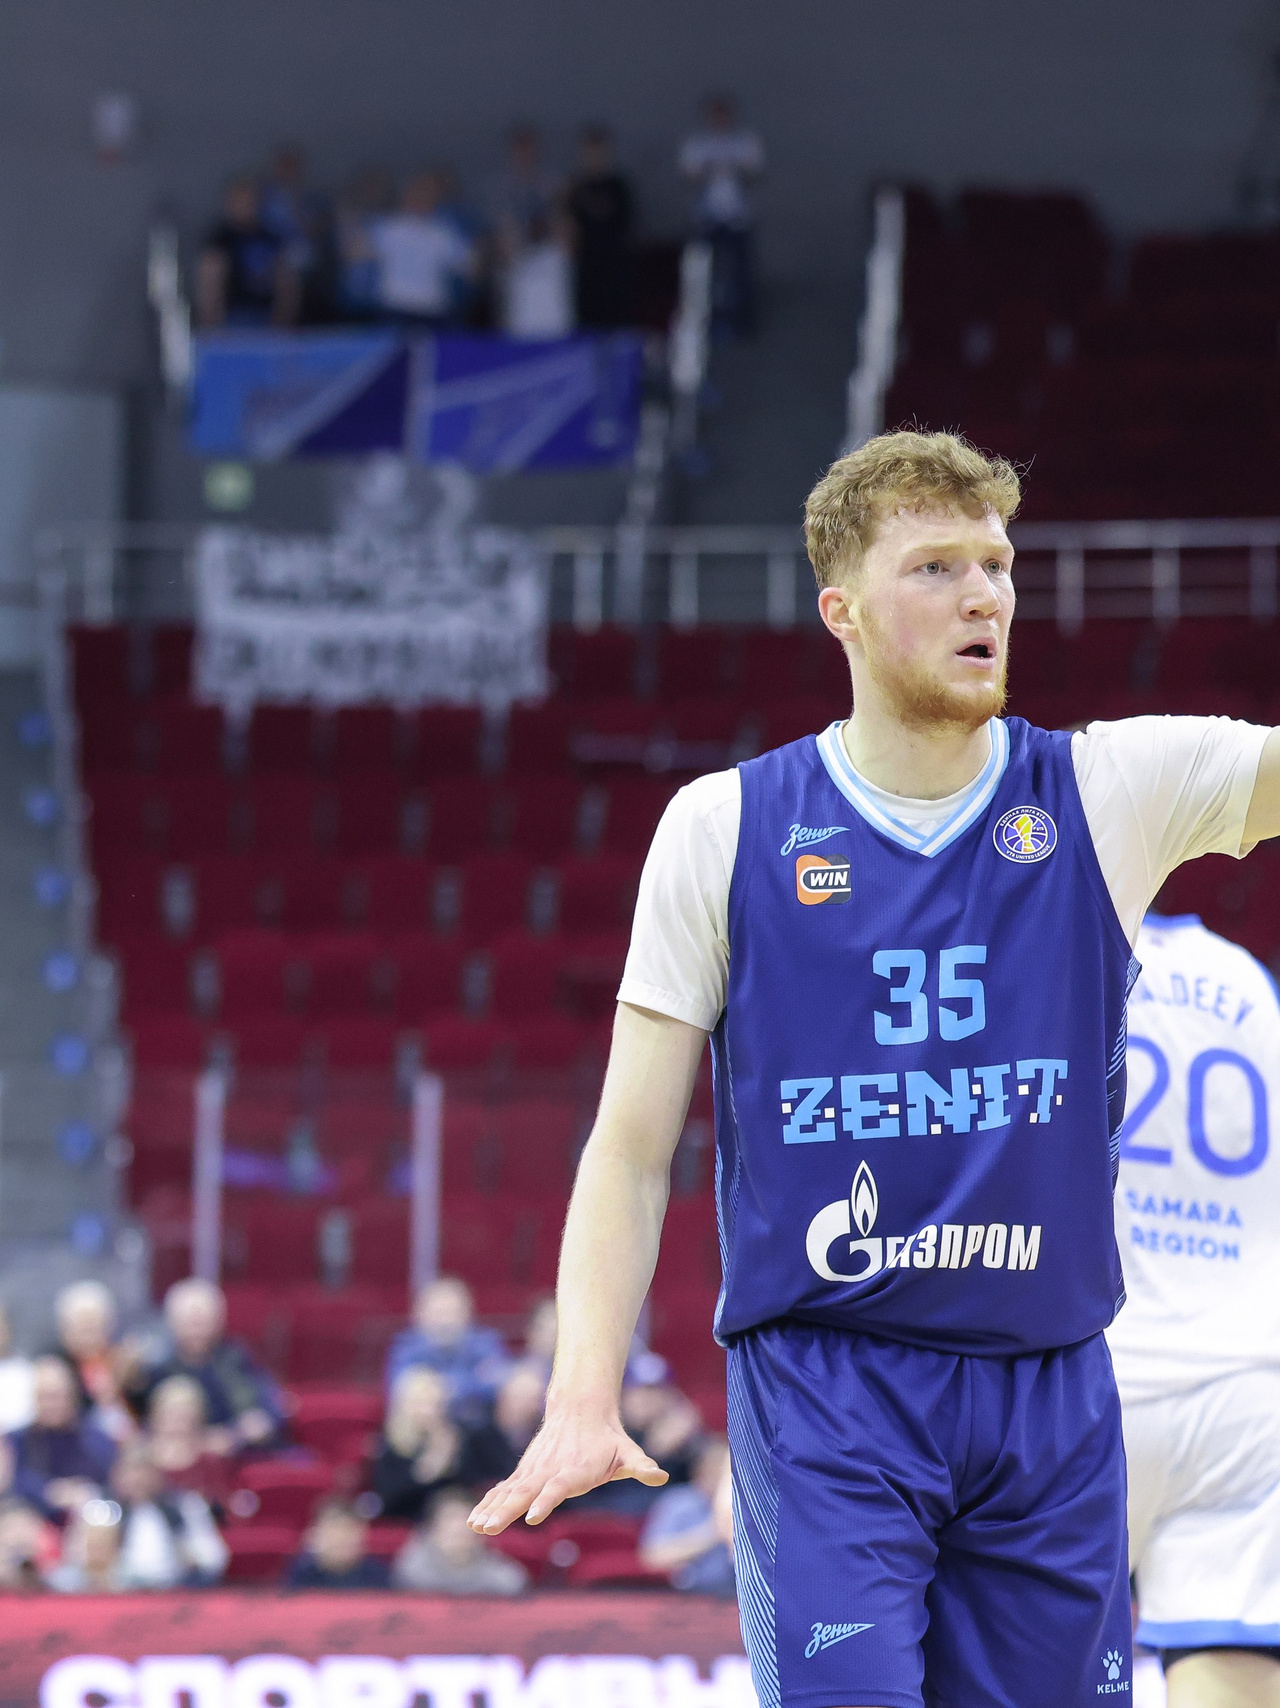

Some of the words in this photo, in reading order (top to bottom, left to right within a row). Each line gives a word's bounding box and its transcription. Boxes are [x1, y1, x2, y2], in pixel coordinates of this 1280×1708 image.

[810, 870, 848, 887] WIN
[872, 944, 987, 1046] 35
[780, 1058, 1069, 1145] ZENIT
[1120, 1034, 1269, 1178] 20
[1125, 1189, 1242, 1228] SAMARA
[1130, 1224, 1241, 1262] REGION
[1096, 1680, 1130, 1695] KELME
